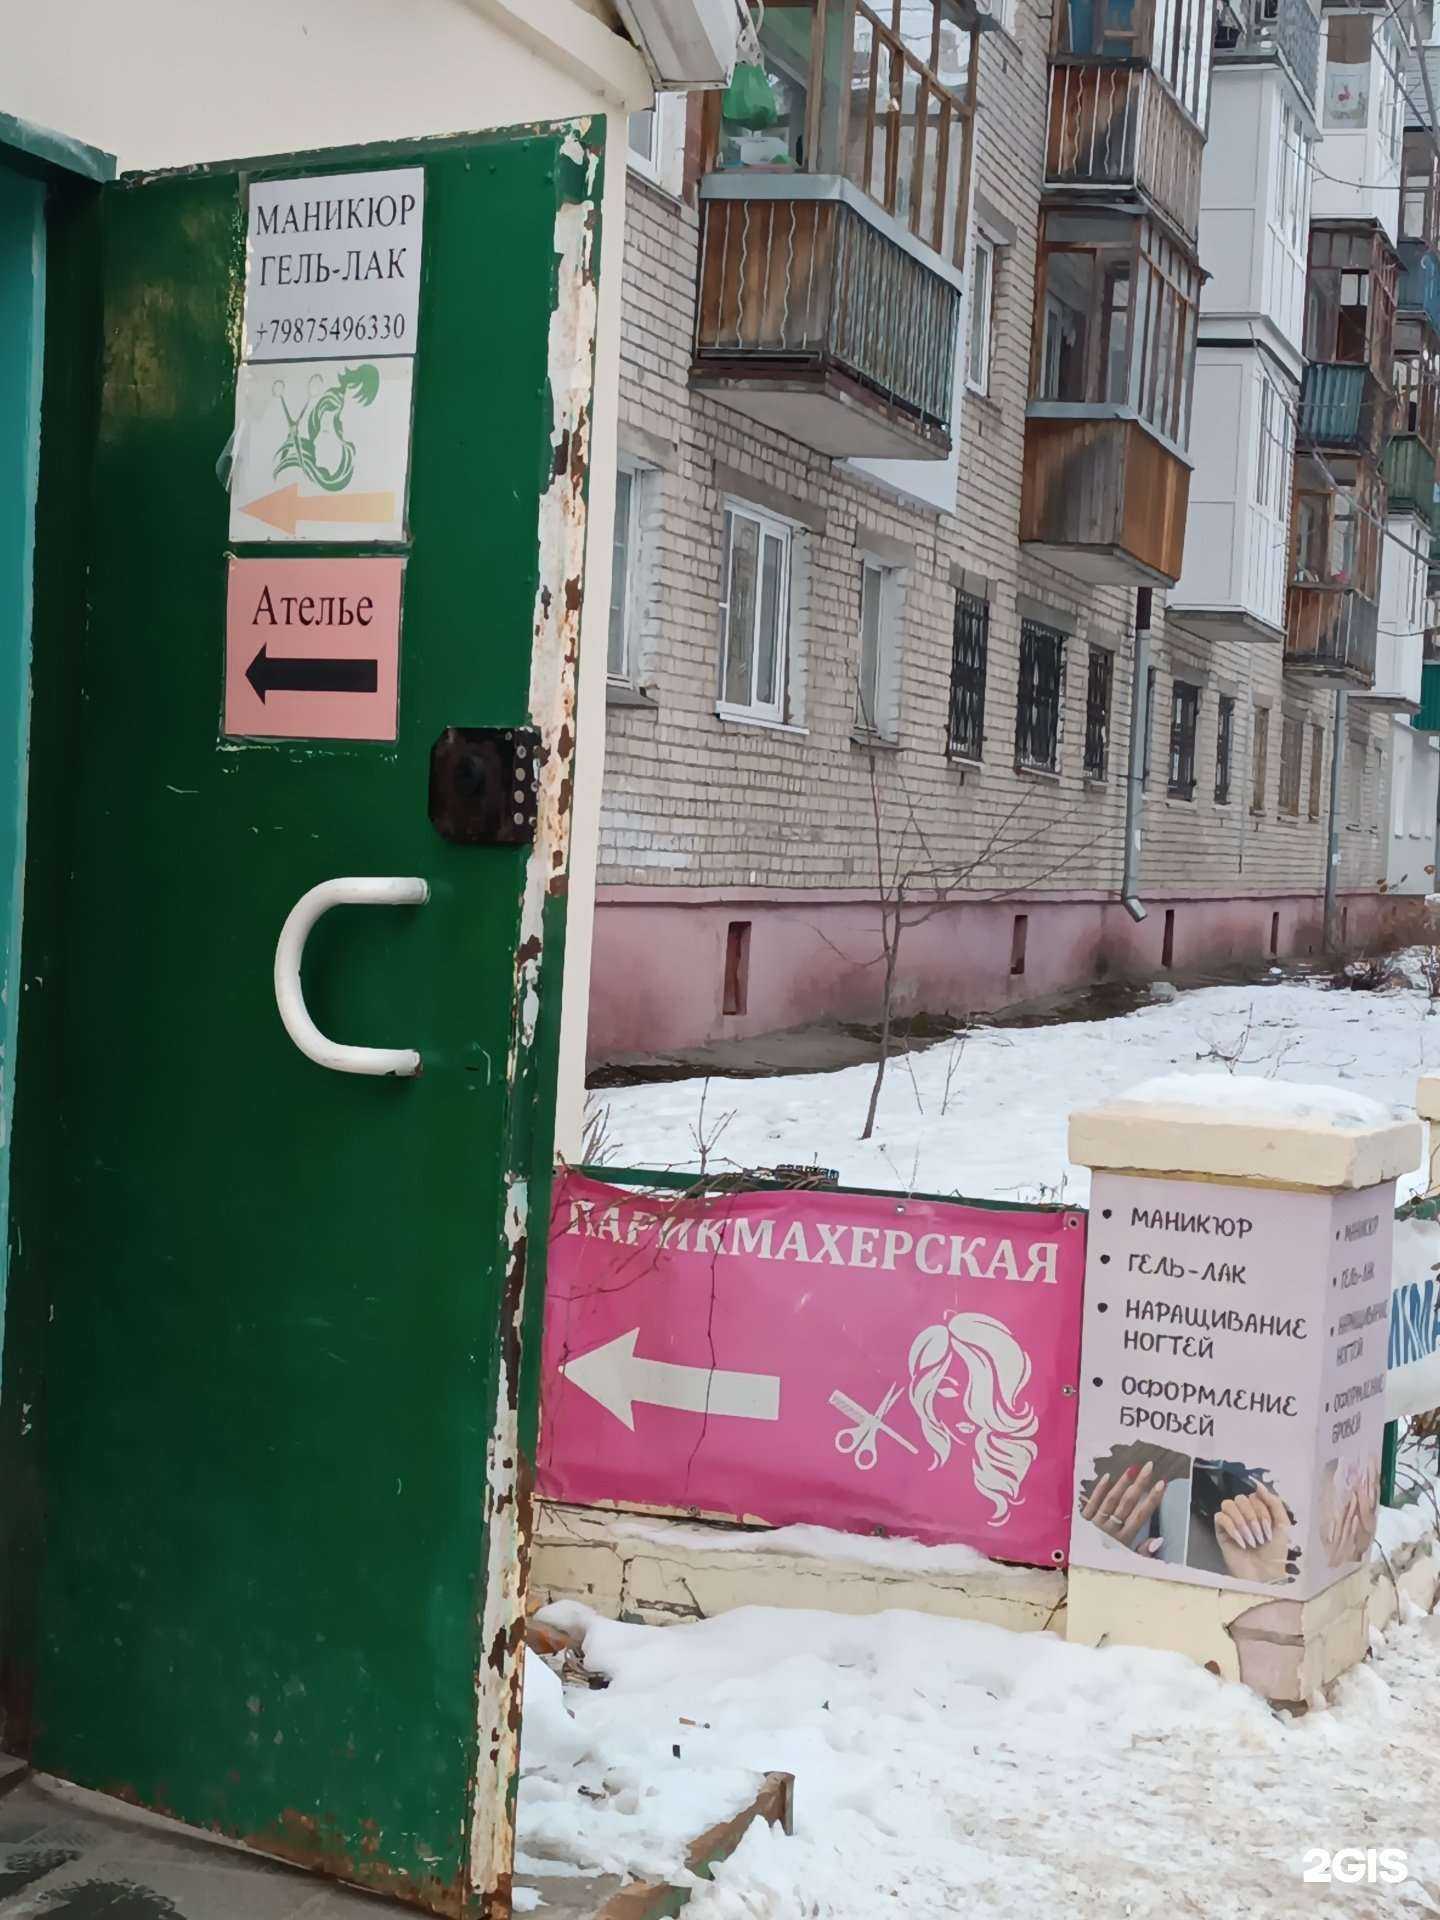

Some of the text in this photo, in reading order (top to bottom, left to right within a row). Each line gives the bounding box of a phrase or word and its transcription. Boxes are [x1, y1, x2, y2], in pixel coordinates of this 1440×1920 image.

[256, 194, 416, 235] МАНИКЮР
[260, 248, 407, 286] ГЕЛЬ-ЛАК
[256, 312, 405, 345] +79875496330
[251, 584, 374, 626] Ателье
[566, 1197, 1059, 1284] ПАРИКМАХЕРСКАЯ
[1131, 1207, 1253, 1239] МАНИКЮР
[1128, 1253, 1247, 1285] ГЕЛЬ-ЛАК
[1125, 1299, 1308, 1340] НАРАЩИВАНИЕ
[1124, 1330, 1214, 1359] НОГТЕЙ
[1121, 1376, 1298, 1417] ОФОРМЛЕНИЕ
[1120, 1407, 1214, 1437] БРОВЕЙ
